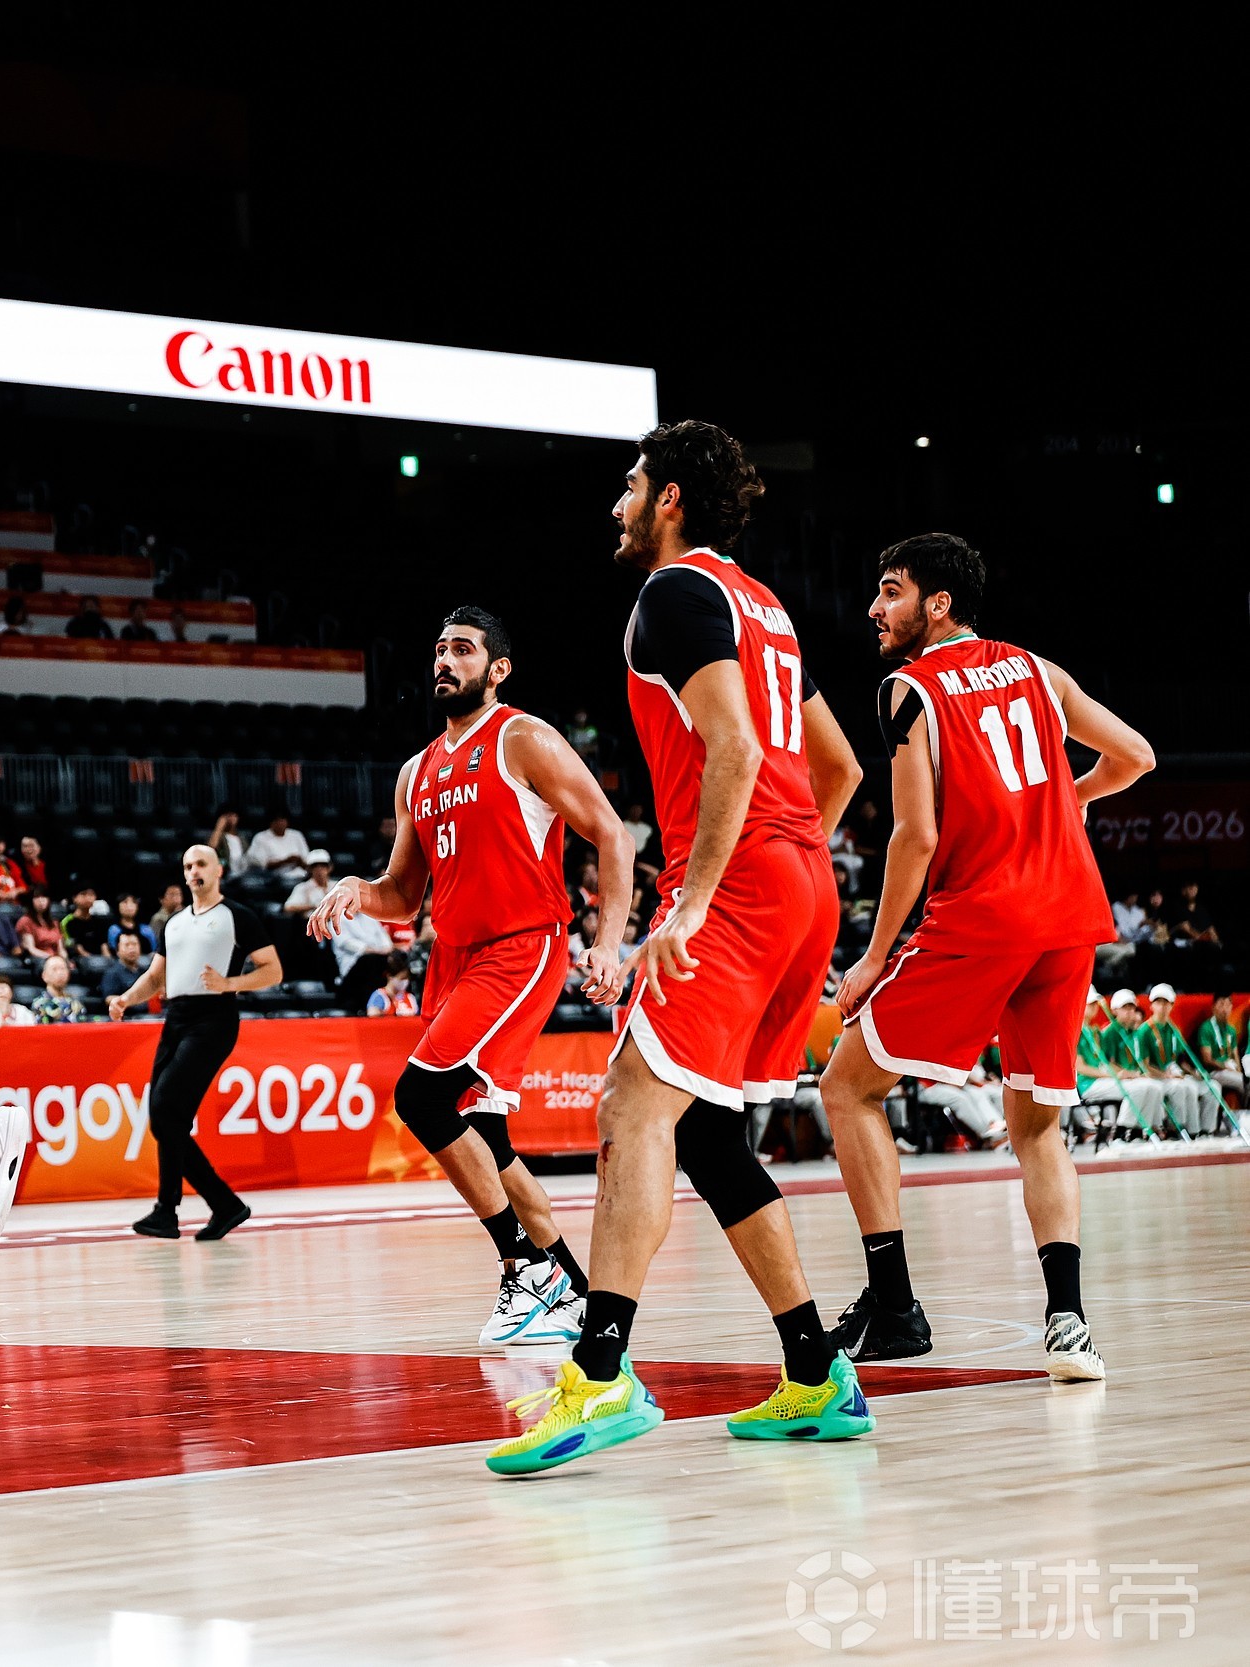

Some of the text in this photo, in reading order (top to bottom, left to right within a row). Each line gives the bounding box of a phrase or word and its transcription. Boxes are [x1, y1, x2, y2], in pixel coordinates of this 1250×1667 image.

[165, 331, 372, 403] Canon
[761, 642, 802, 756] 17
[977, 696, 1049, 793] 11
[436, 820, 457, 860] 51
[1161, 808, 1246, 842] 2026
[217, 1062, 376, 1136] 2026
[544, 1090, 596, 1109] 2026
